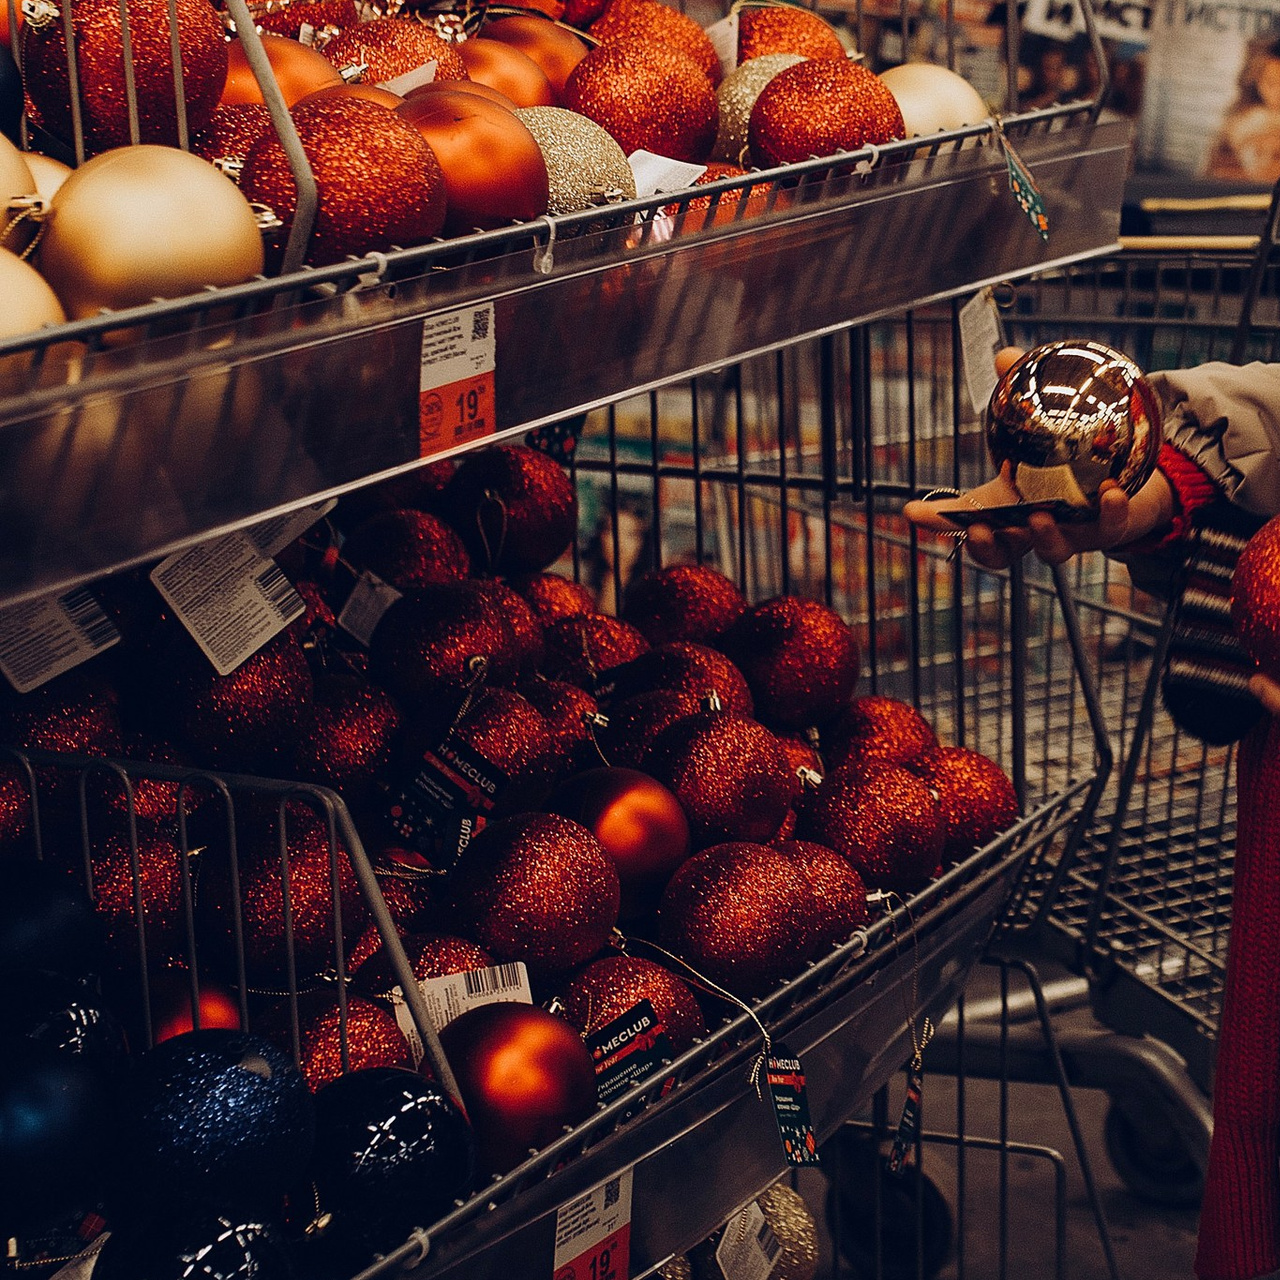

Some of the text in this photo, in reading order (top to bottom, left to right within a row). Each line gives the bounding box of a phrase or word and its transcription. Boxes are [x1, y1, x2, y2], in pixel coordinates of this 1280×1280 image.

[438, 743, 497, 794] HOMECLUB
[593, 1016, 651, 1060] OMECLUB
[768, 1057, 801, 1071] HOMECLUB
